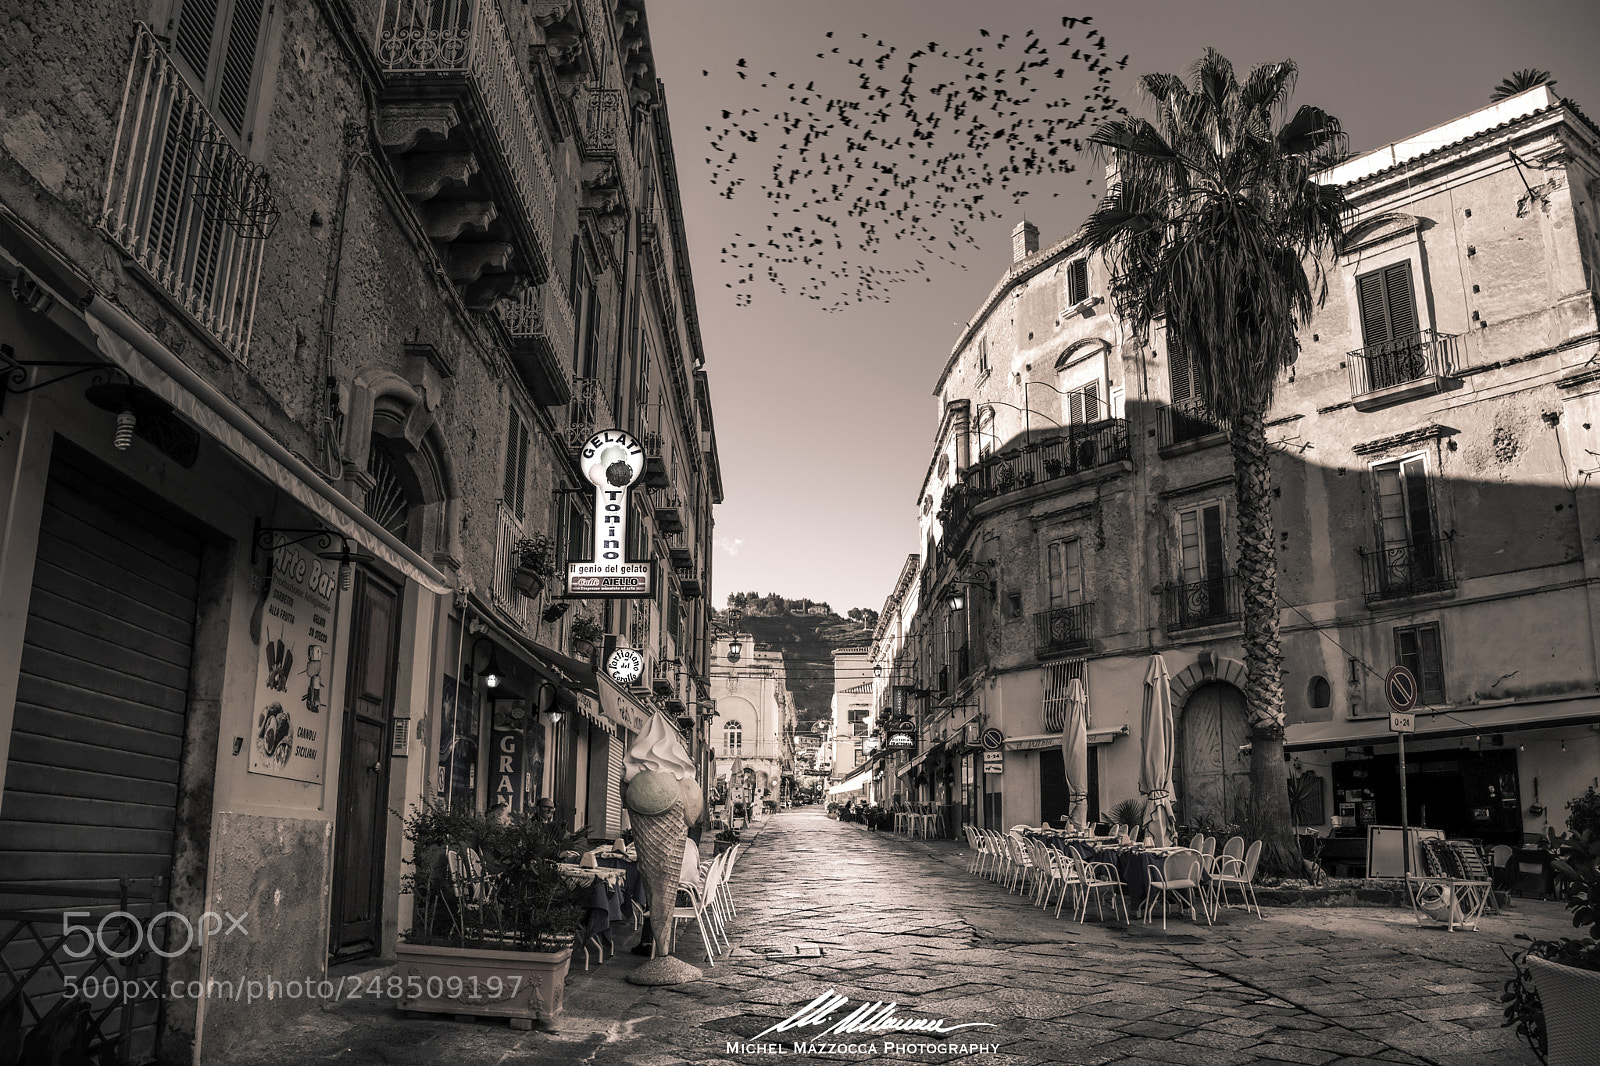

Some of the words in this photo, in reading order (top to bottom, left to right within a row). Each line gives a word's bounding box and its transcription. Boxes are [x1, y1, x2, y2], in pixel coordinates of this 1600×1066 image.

[583, 432, 641, 459] GELATI
[603, 490, 622, 560] Tonino
[273, 536, 306, 584] Arte
[308, 559, 336, 601] Bar
[570, 564, 576, 573] il
[578, 564, 602, 575] genio
[605, 564, 618, 573] del
[621, 564, 648, 575] gelato
[602, 578, 638, 586] AIELLO
[269, 604, 279, 617] ALLA
[280, 609, 295, 625] FRUTTA
[297, 726, 317, 741] CANNOLI
[295, 745, 318, 760] SICILIANI
